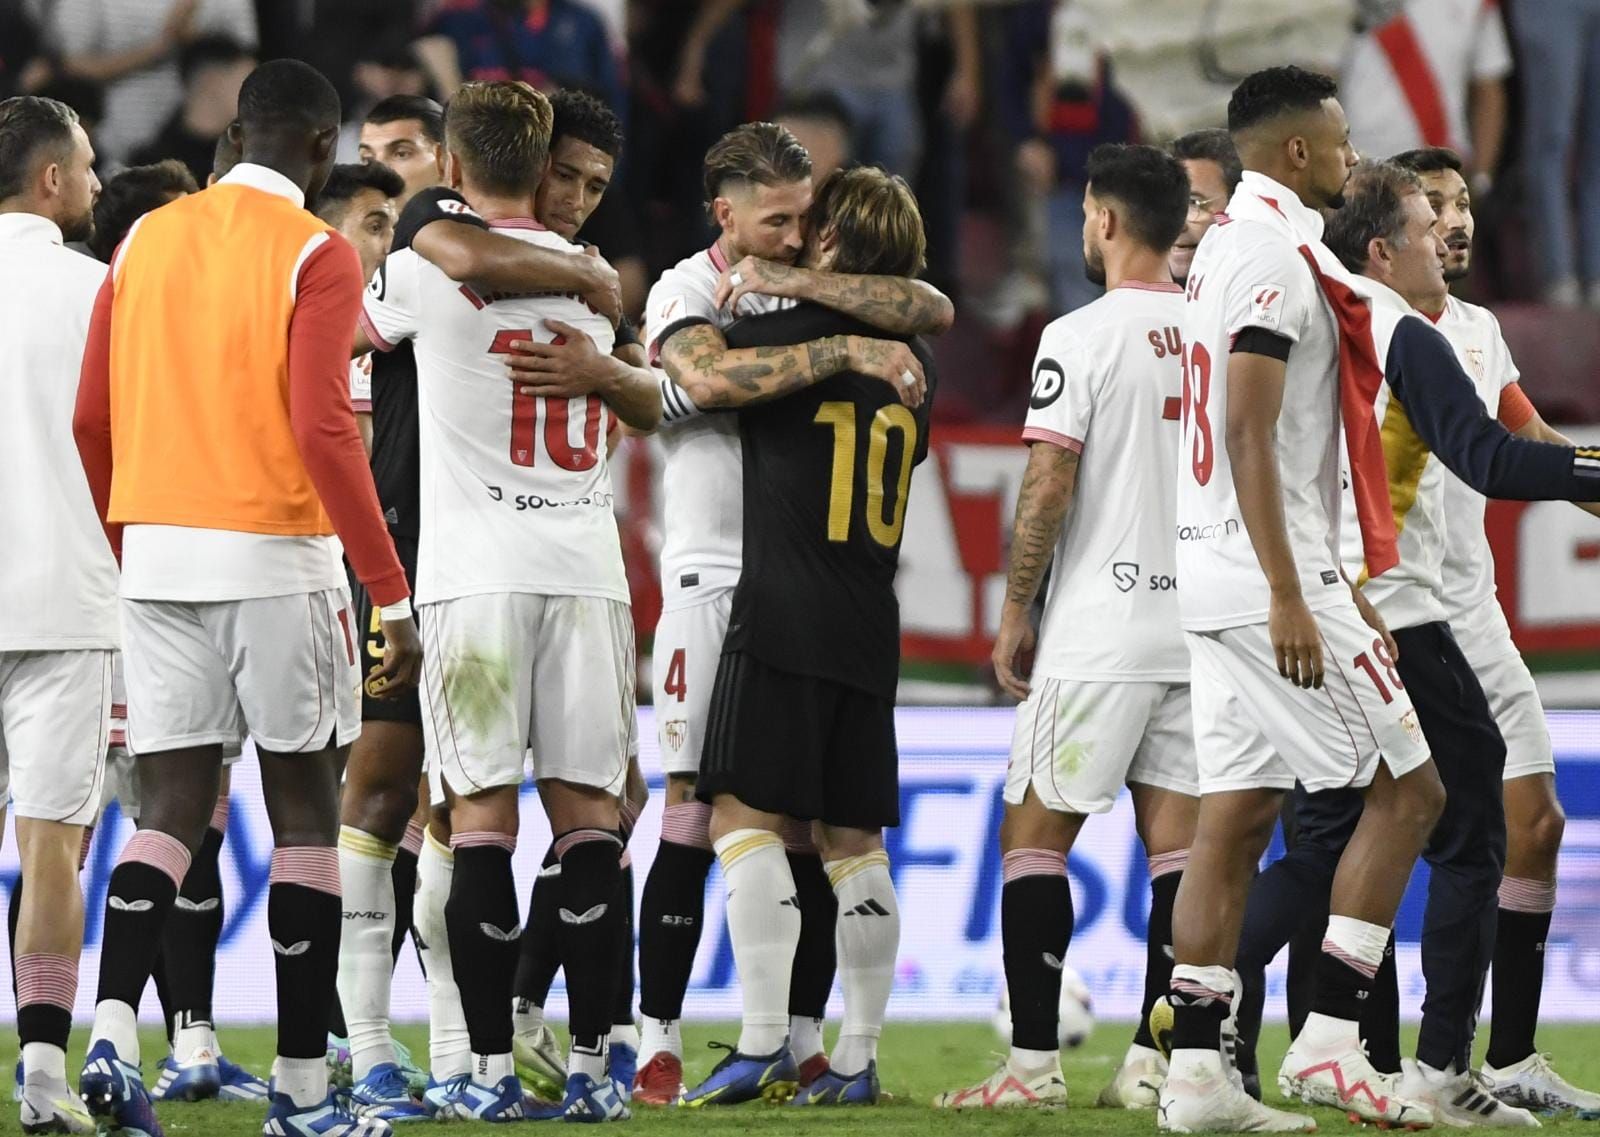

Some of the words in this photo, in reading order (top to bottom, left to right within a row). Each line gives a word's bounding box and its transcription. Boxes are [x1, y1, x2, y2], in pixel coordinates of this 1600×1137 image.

[488, 329, 601, 472] 10
[814, 401, 917, 547] 10
[664, 648, 687, 703] 4
[1353, 638, 1405, 705] 18
[661, 914, 694, 925] SFC
